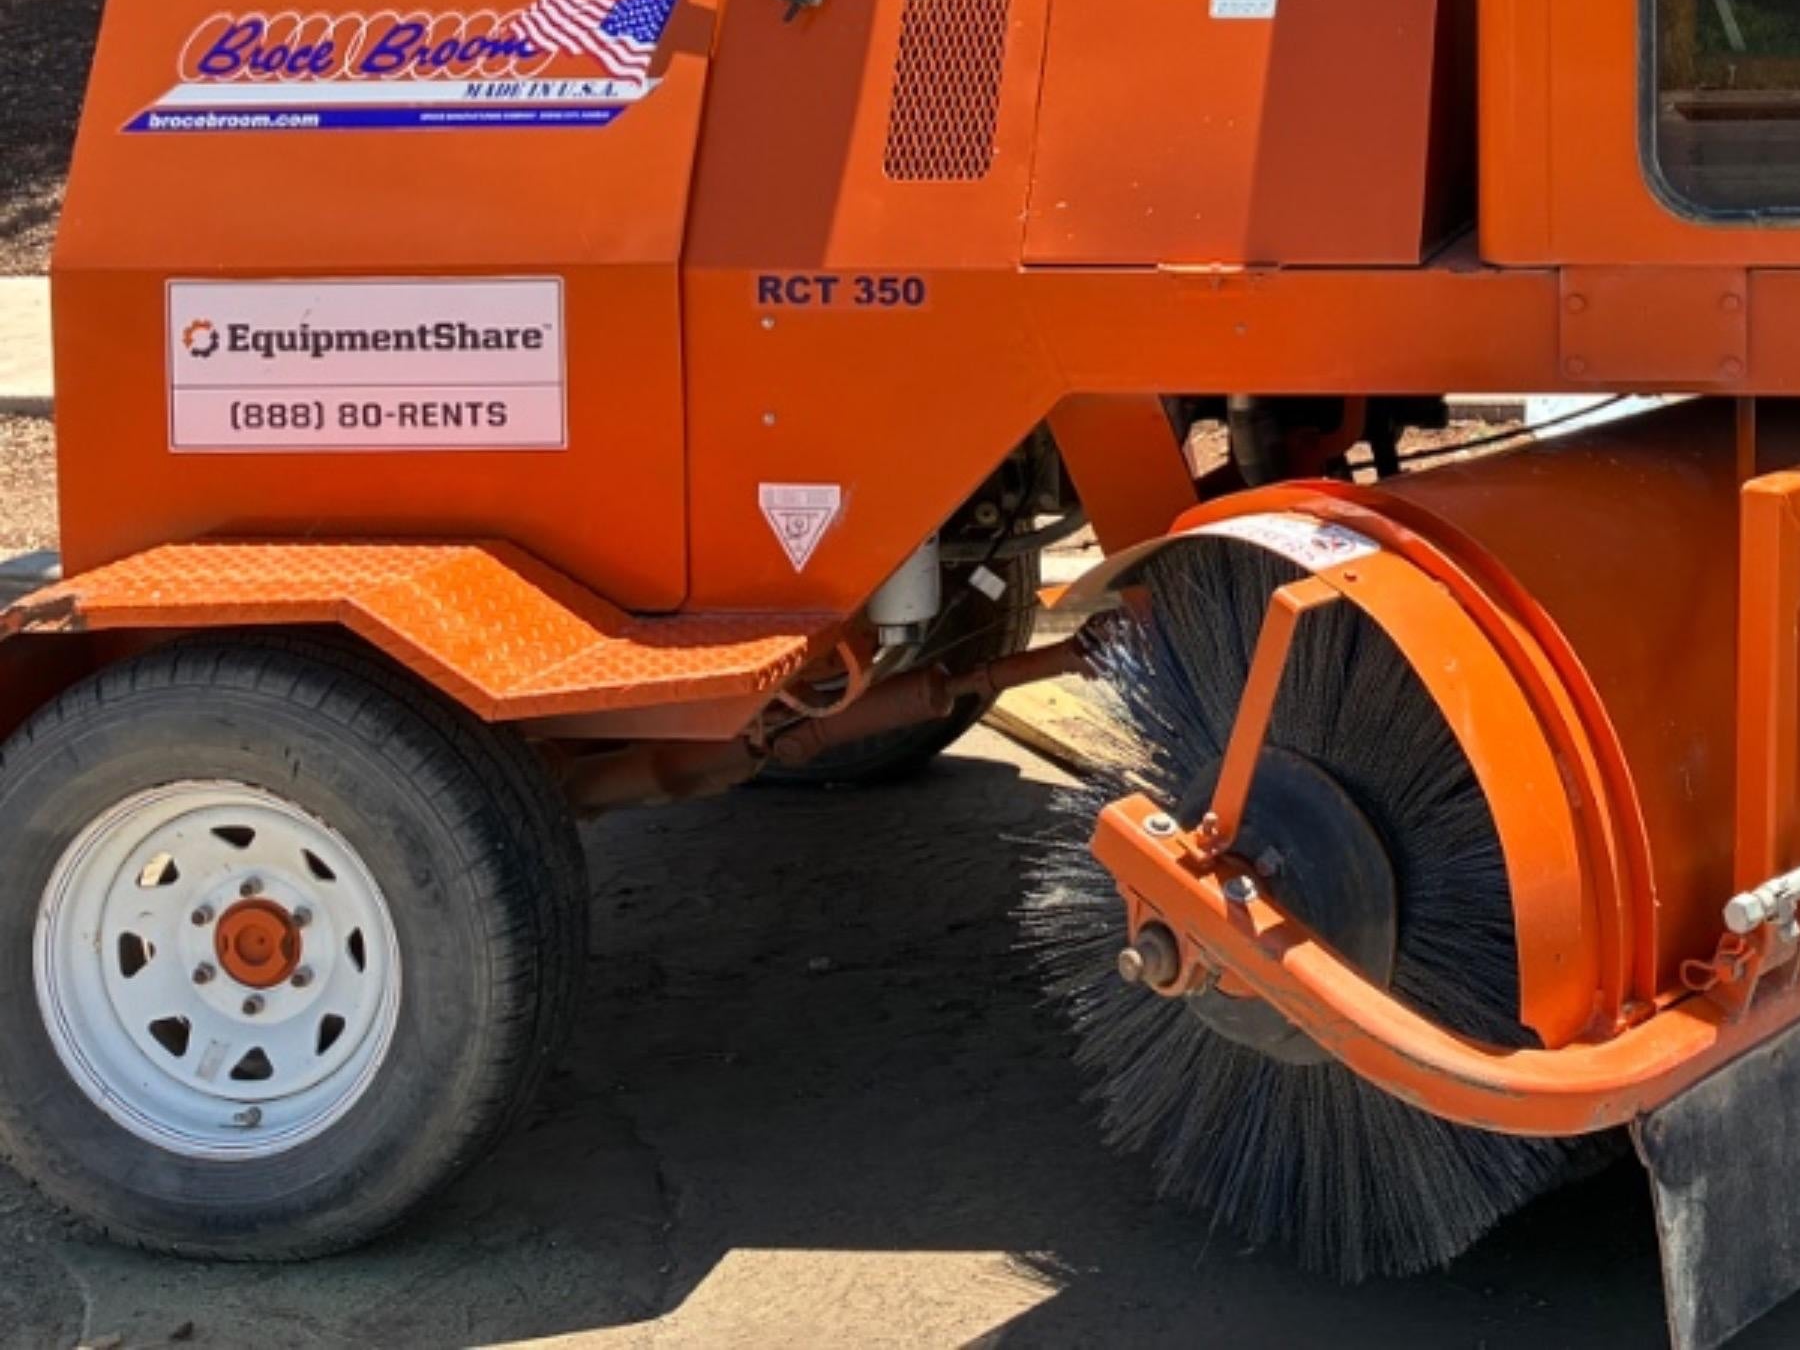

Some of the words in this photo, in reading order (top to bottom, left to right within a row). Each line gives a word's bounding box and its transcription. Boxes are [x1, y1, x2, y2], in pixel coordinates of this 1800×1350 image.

[197, 19, 335, 74] Broce
[360, 22, 541, 74] Broom
[148, 111, 320, 129] brocebroom.com
[757, 274, 840, 306] RCT
[853, 274, 926, 307] 350
[230, 401, 326, 431] (888)
[338, 402, 508, 429] 80-RENTS
